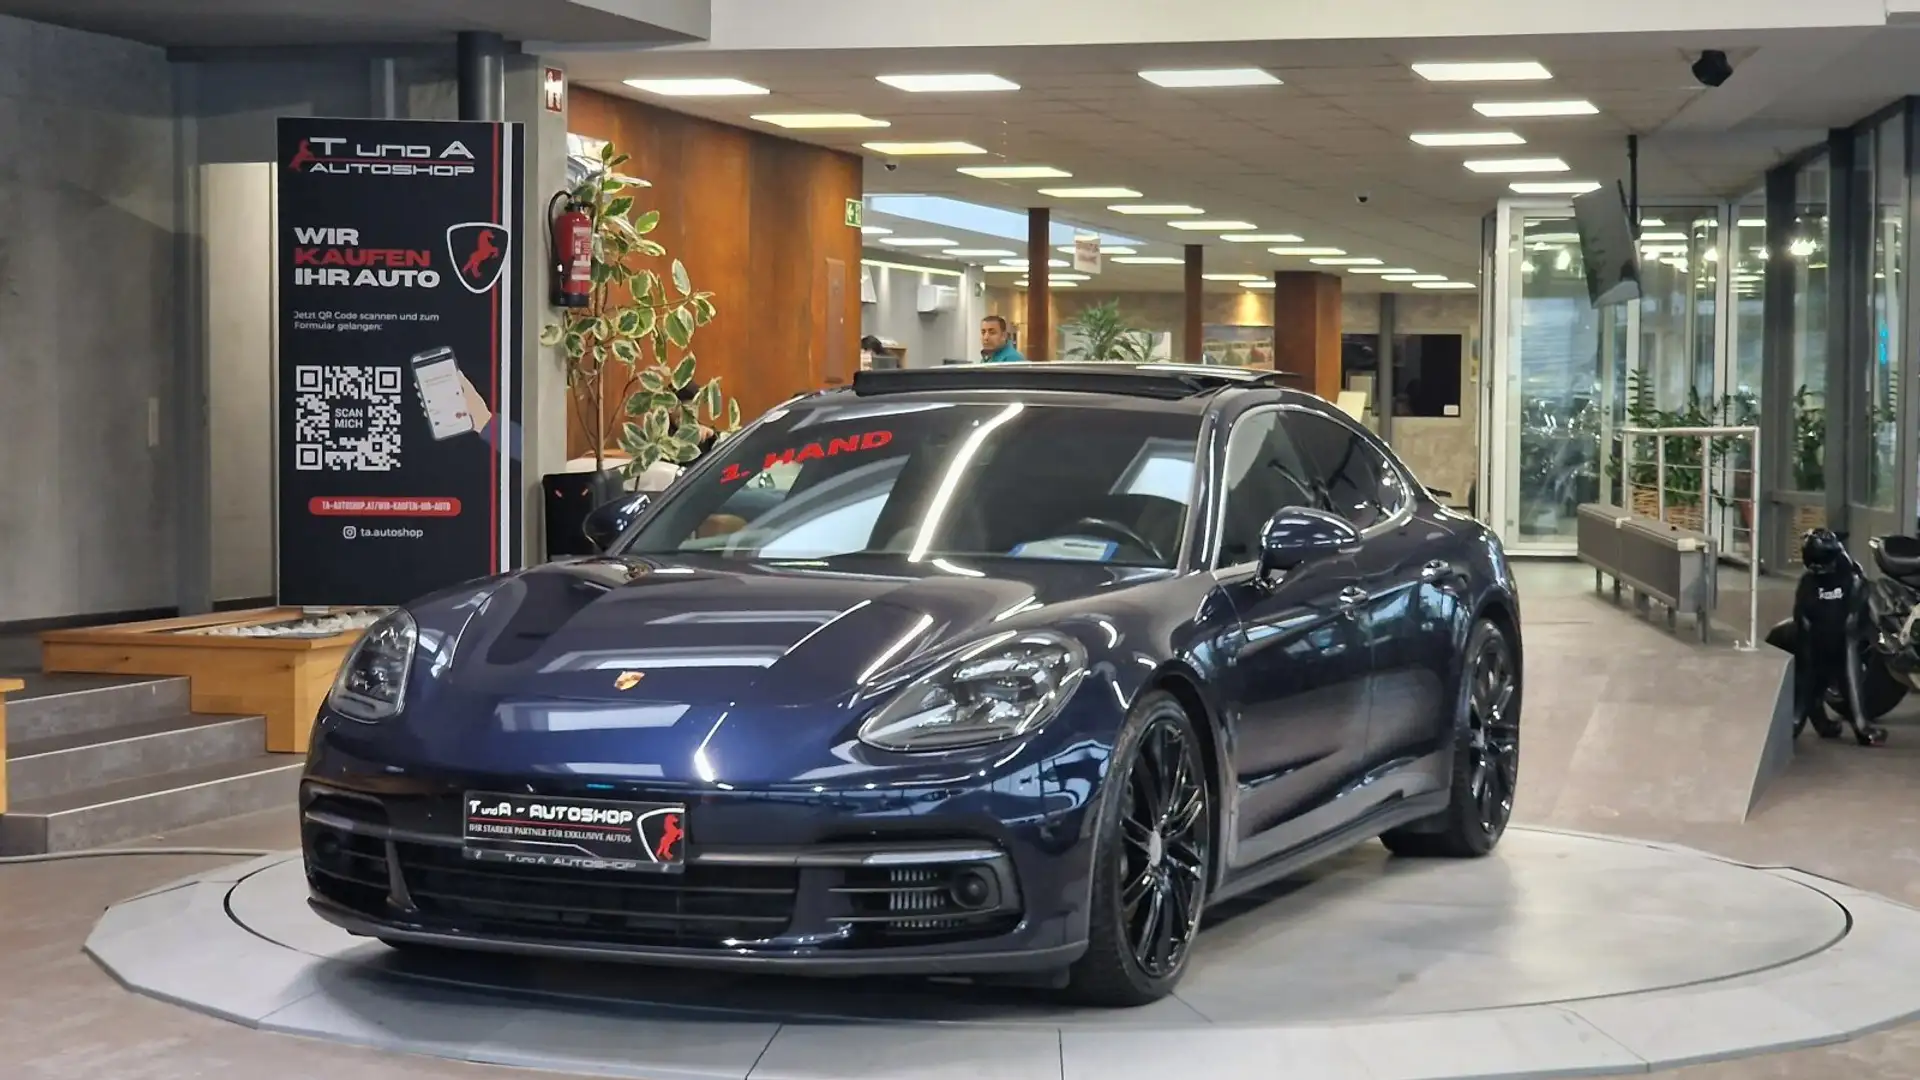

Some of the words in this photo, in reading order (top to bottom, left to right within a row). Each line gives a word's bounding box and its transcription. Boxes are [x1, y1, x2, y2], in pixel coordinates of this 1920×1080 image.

[310, 137, 346, 156] T
[439, 140, 475, 159] A
[309, 162, 475, 176] AUTOSHOP
[294, 227, 359, 246] WIR
[294, 247, 431, 267] KAUFEN
[294, 268, 350, 286] IHR
[353, 269, 441, 288] AUTO
[294, 311, 316, 319] Jetzt
[318, 311, 333, 320] QR
[334, 312, 358, 320] Code
[359, 313, 398, 321] scannen
[400, 313, 418, 321] und
[294, 321, 335, 330] Formular
[337, 322, 383, 332] gelangen:
[334, 408, 363, 418] SCAN
[334, 419, 363, 429] MICH
[720, 463, 751, 484] 1.
[763, 431, 893, 470] HAND
[360, 528, 424, 538] ta.autoshop
[529, 804, 634, 825] AUTOSHOP
[514, 826, 547, 836] PARTNER
[548, 829, 563, 838] FÜR
[605, 834, 632, 843] AUTOS
